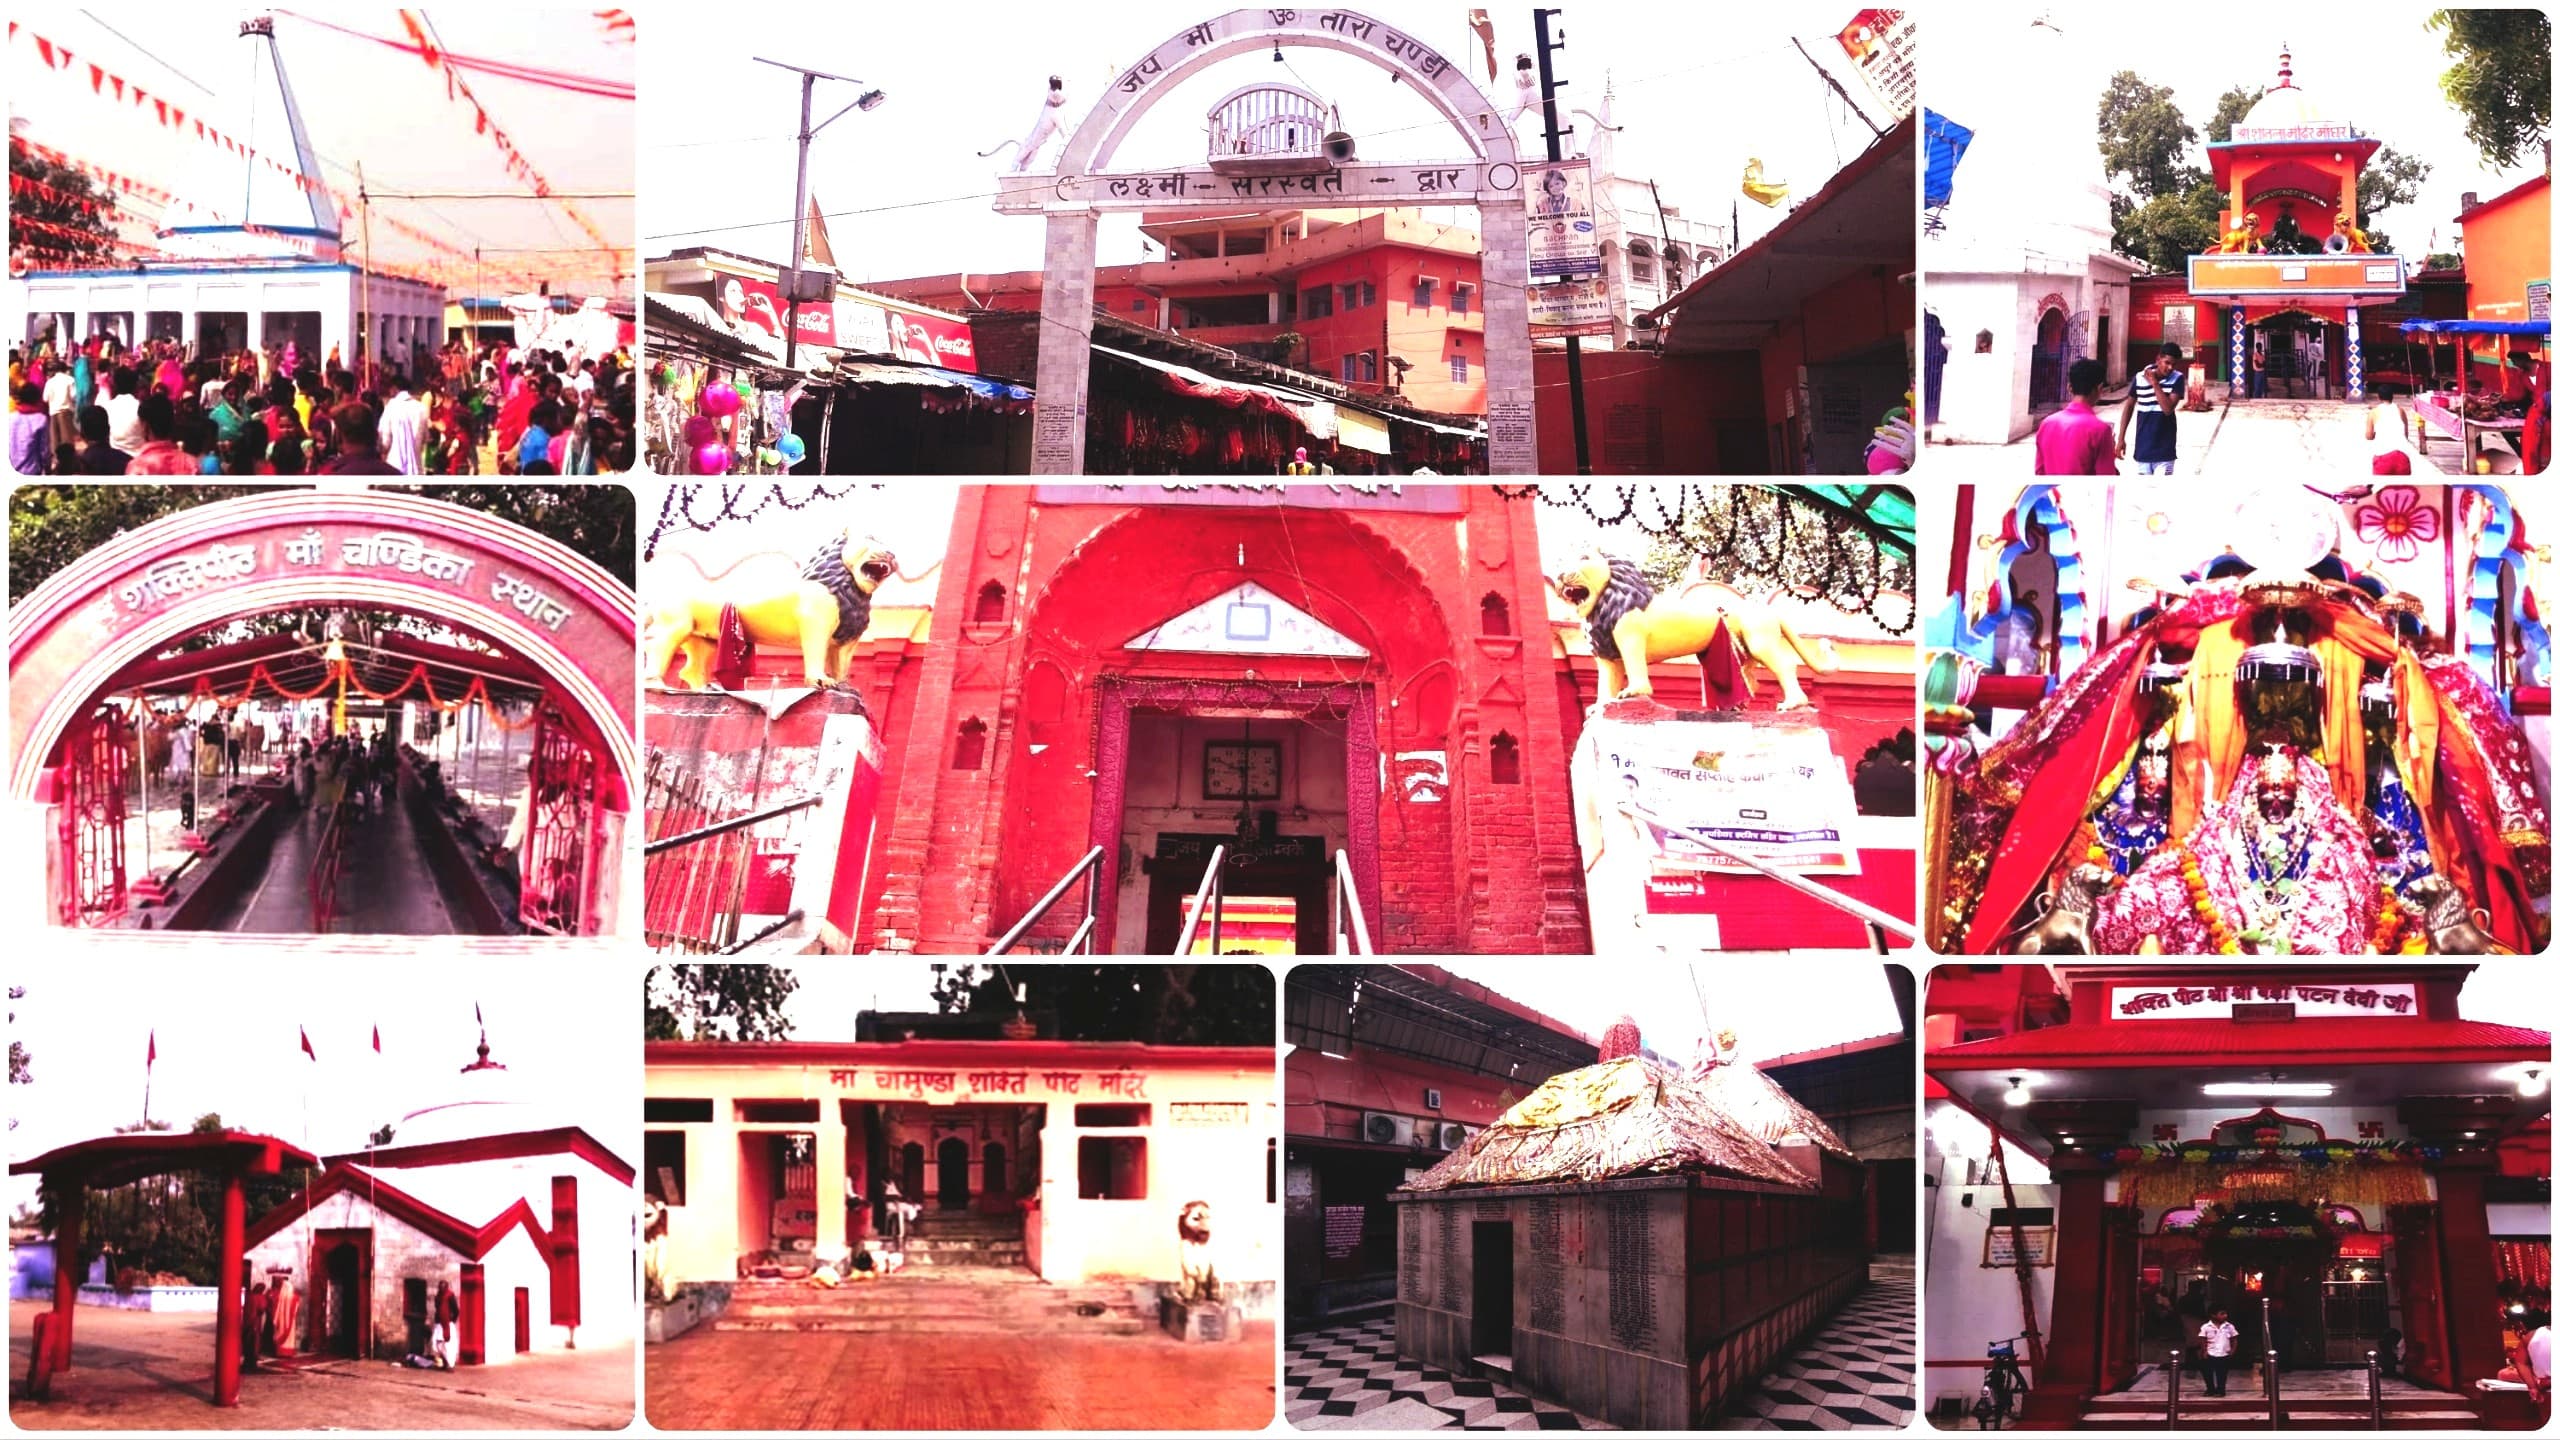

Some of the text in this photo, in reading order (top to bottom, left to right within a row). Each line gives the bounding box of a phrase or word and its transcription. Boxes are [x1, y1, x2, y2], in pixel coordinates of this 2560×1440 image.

[1117, 54, 1162, 93] जय
[1320, 12, 1377, 40] तारा
[1107, 173, 1190, 197] लक्ष्मी
[1411, 168, 1466, 192] द्वार
[341, 532, 476, 586] चण्डिका
[491, 572, 573, 632] स्थान
[2120, 992, 2172, 1014] शक्ति
[2172, 987, 2205, 1006] पीठ
[2295, 986, 2341, 1004] पटन
[2382, 994, 2413, 1014] जी
